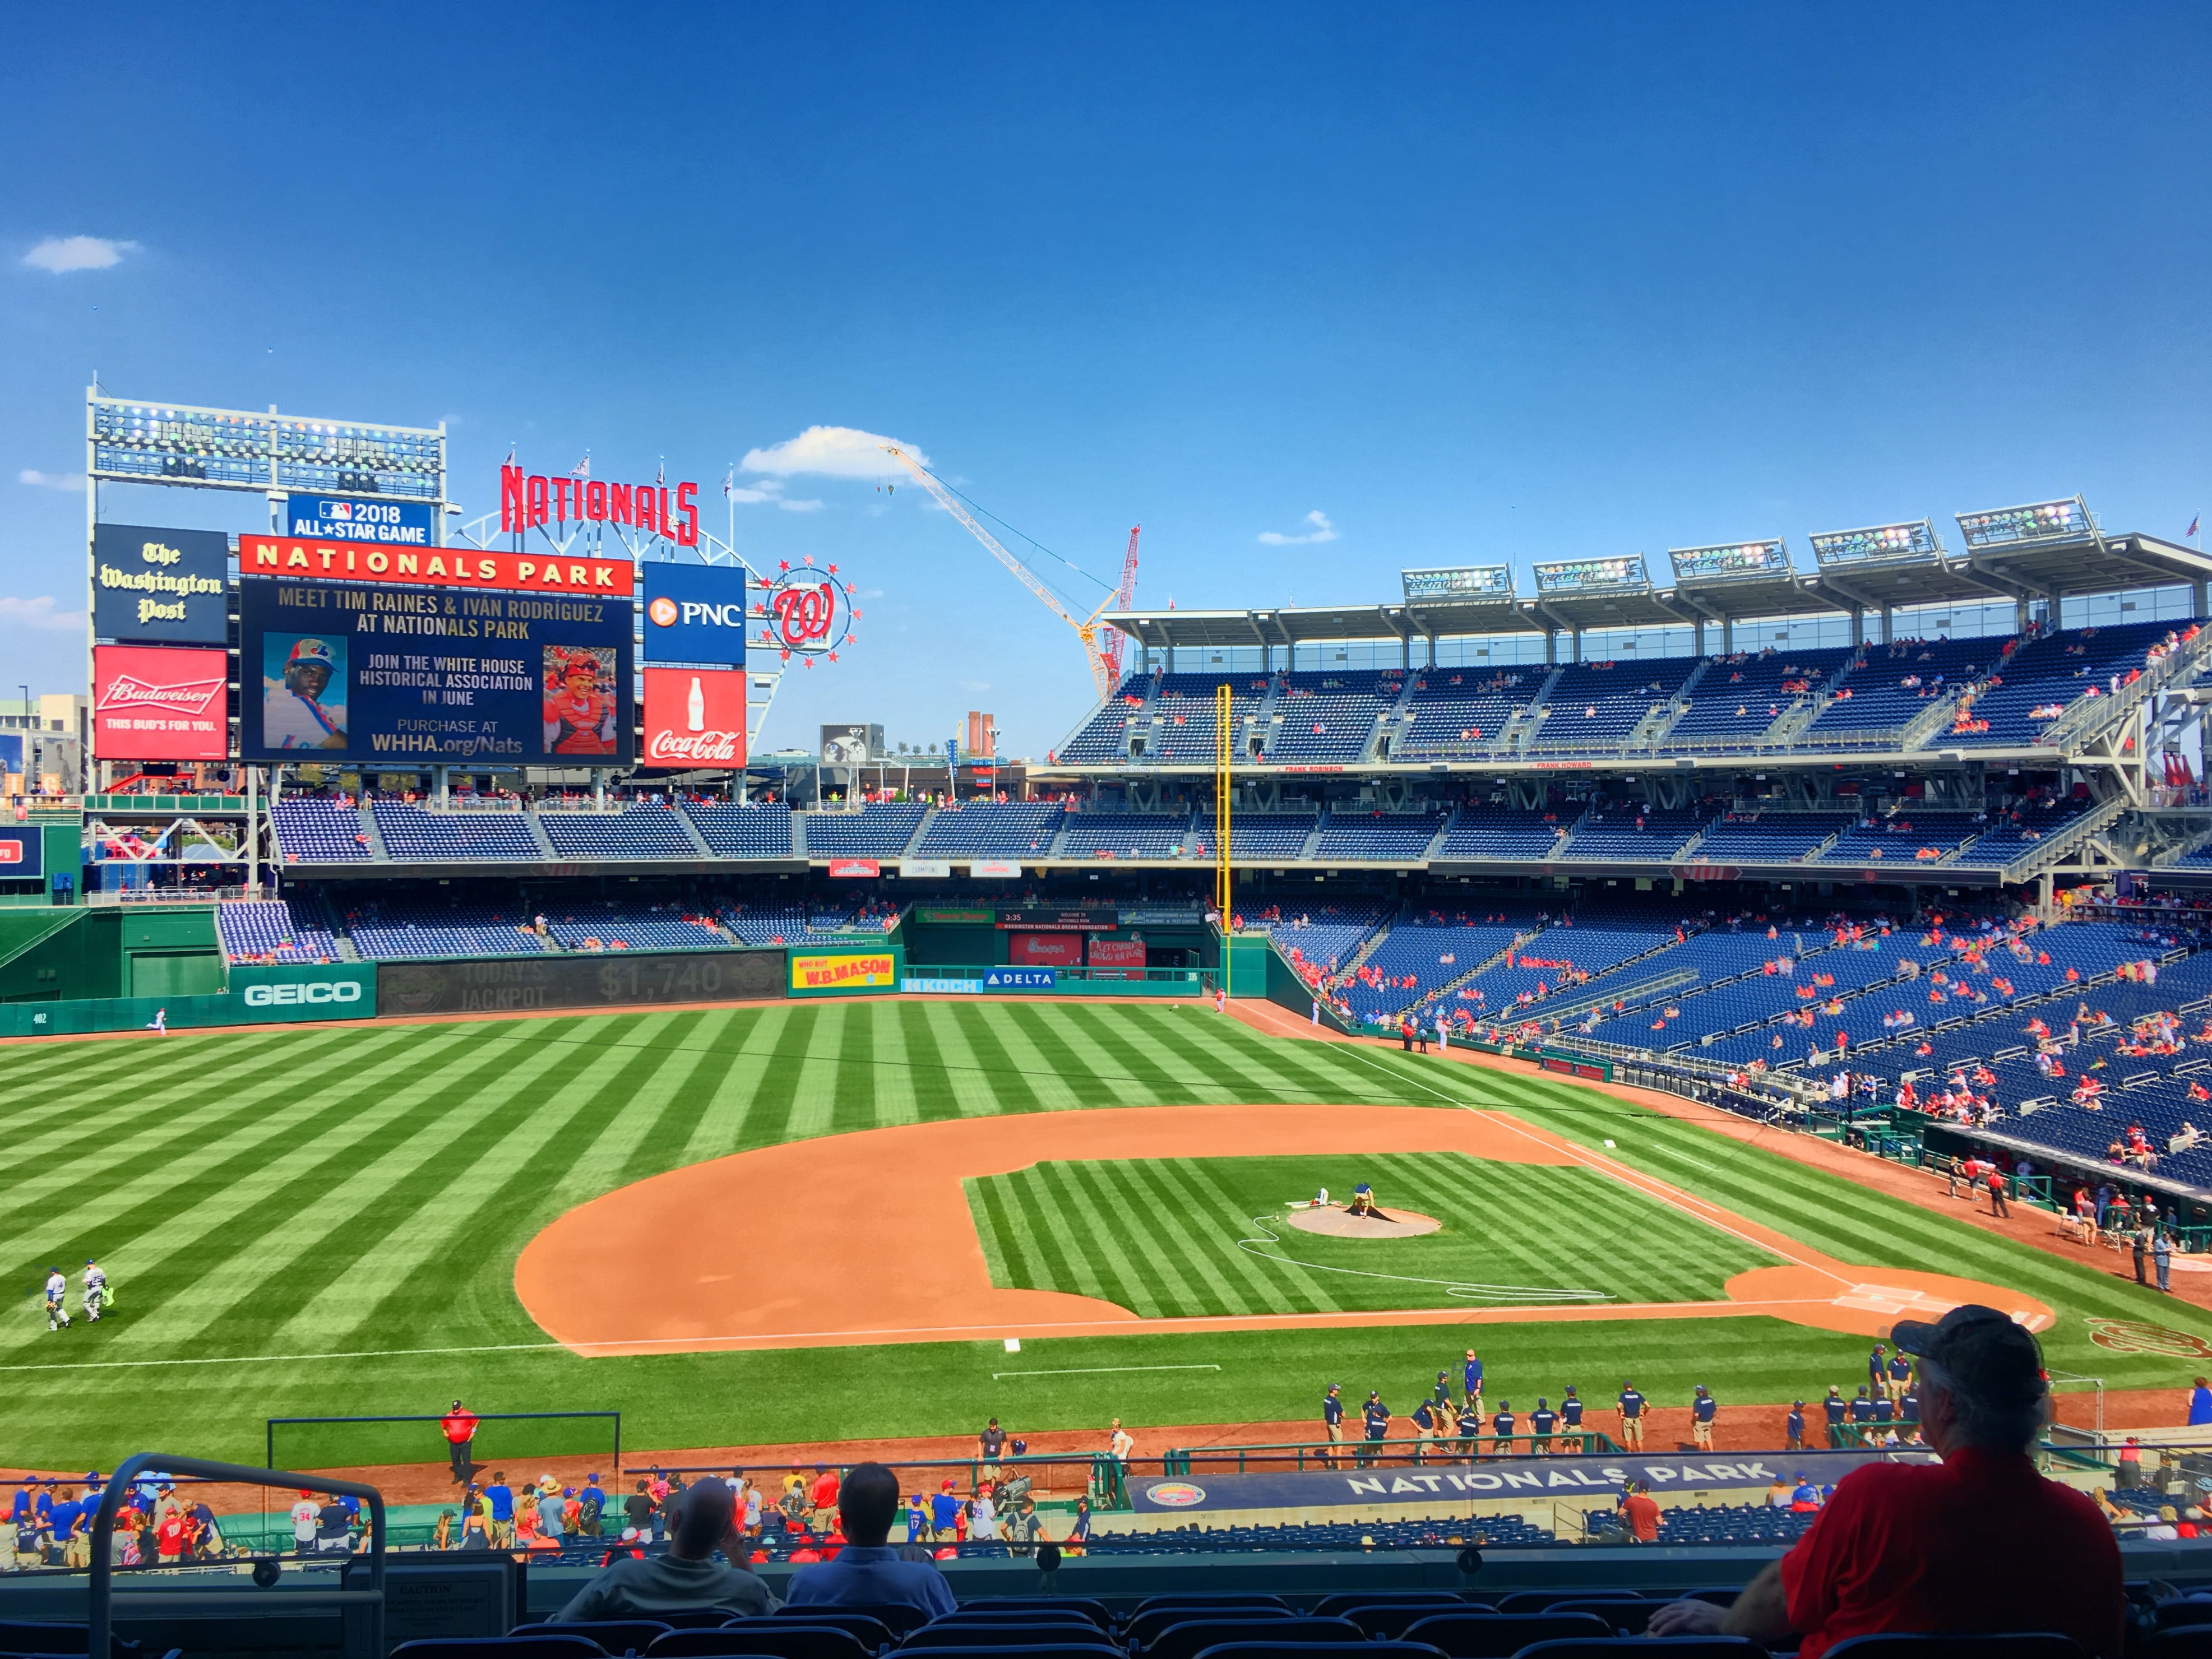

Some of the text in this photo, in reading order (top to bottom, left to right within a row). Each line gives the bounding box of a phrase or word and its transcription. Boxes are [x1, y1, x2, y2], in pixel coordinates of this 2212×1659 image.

[355, 504, 401, 524] 2018
[501, 465, 698, 546] NATIONALS
[335, 522, 375, 540] STAR
[378, 523, 425, 544] GAME
[142, 542, 181, 566] The
[256, 543, 614, 587] NATIONALS PARK
[100, 563, 223, 597] Washington
[137, 598, 186, 624] Post
[279, 587, 604, 623] MEET TIM RAINES & IVÁN RODRÍGUEZ
[681, 603, 741, 627] PNC
[357, 614, 530, 640] AT NATIONALS PARK
[368, 654, 525, 674] JOIN THE WHITE HOUSE
[359, 670, 533, 691] HISTORICAL ASSOCIATION
[108, 683, 212, 703] Budweiser
[422, 690, 475, 706] IN JUNE
[105, 718, 217, 731] THIS BUD'S FOR YOU.
[397, 719, 498, 734] PURCHASE AT
[372, 734, 523, 755] WHHA.org/Nats
[650, 729, 741, 760] Coca-Cola
[462, 961, 543, 984] TODAY'S
[600, 960, 722, 1001] $1,740
[1003, 974, 1052, 984] DELTA
[1188, 972, 1197, 981] 335
[244, 981, 362, 1007] GEICO
[925, 980, 977, 993] KOCH
[461, 986, 547, 1011] JACKPOT
[33, 1013, 47, 1025] 402
[92, 1276, 102, 1284] 25
[1346, 1462, 1778, 1495] NATIONALS PARK
[299, 1513, 310, 1521] 34
[910, 1519, 919, 1530] 17
[400, 1586, 451, 1595] CAUTION
